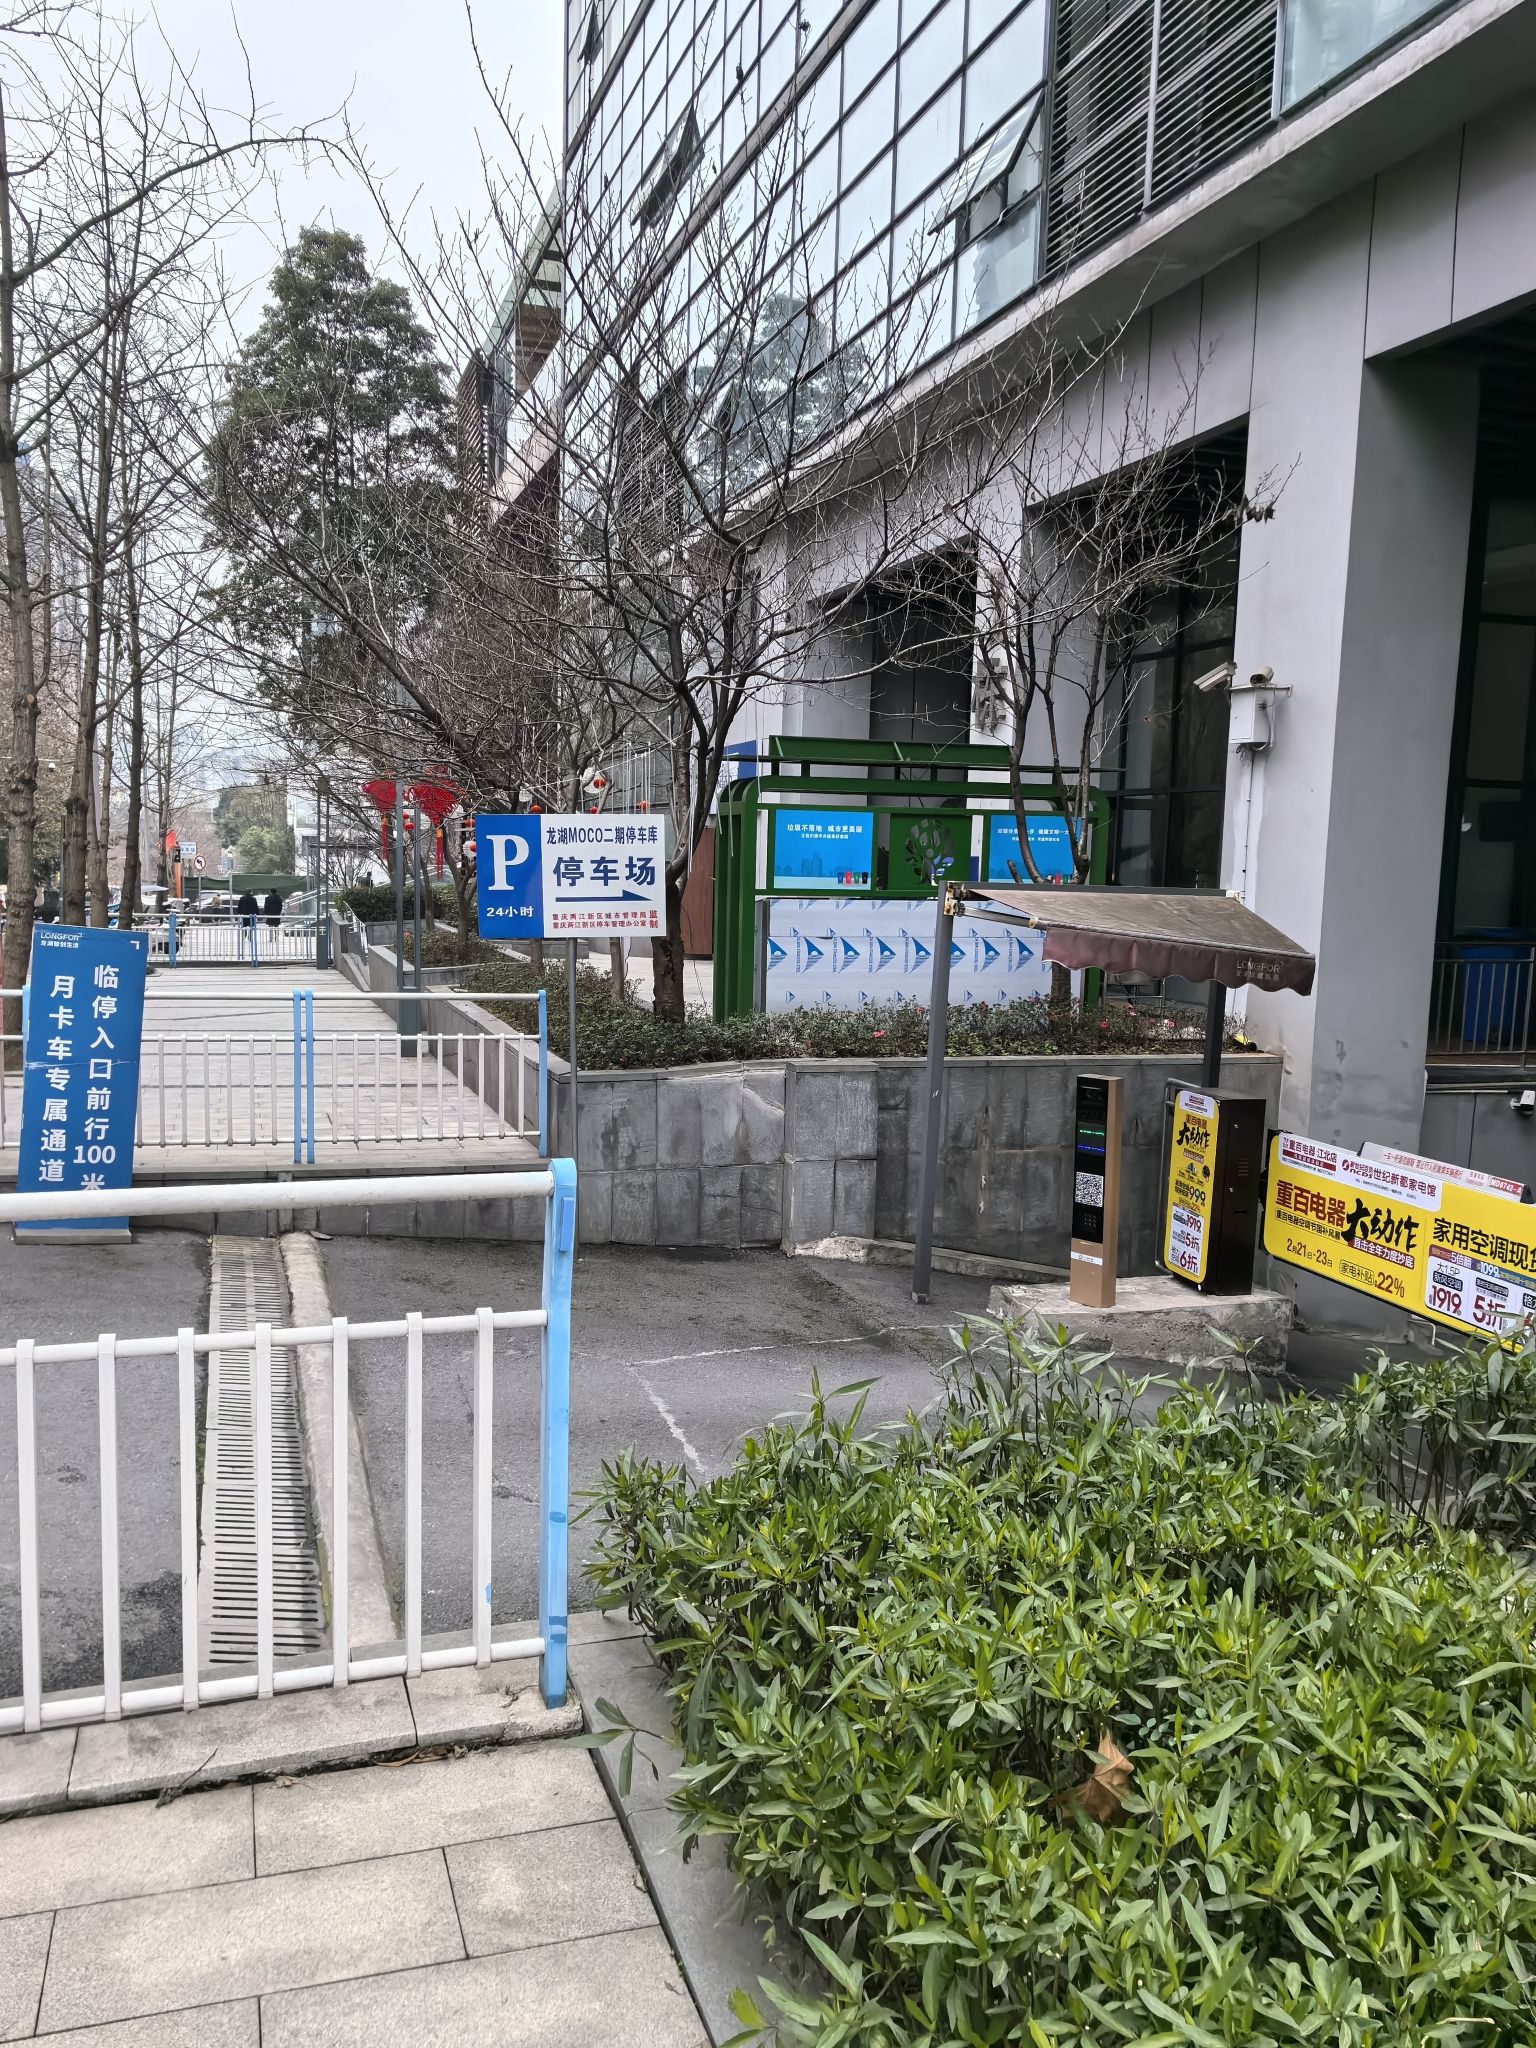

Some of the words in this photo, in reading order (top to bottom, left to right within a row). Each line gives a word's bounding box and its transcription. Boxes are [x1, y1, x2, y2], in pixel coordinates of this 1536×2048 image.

[546, 825, 658, 845] 龙湖MOCO二期停车库
[786, 824, 823, 832] 垃圾不落地
[486, 834, 529, 891] P
[552, 856, 656, 886] 停车场
[486, 905, 534, 918] 24小时
[552, 911, 647, 920] 重庆两江新区城市管理局
[552, 920, 647, 929] 重庆两江新区停车管理办公室
[40, 932, 81, 941] LONGFOR
[1236, 960, 1281, 973] LONGFOR
[38, 975, 76, 1183] 月卡车专属通道
[1176, 1121, 1211, 1149] 大动作
[1288, 1138, 1316, 1155] 重百电器
[1316, 1147, 1337, 1164] 江北店
[1373, 1167, 1437, 1198] 世纪新都家电馆
[1276, 1179, 1346, 1229] 重百电器
[1341, 1198, 1420, 1252] 大动作
[1341, 1262, 1374, 1285] 家电补贴
[1377, 1271, 1405, 1298] 22%
